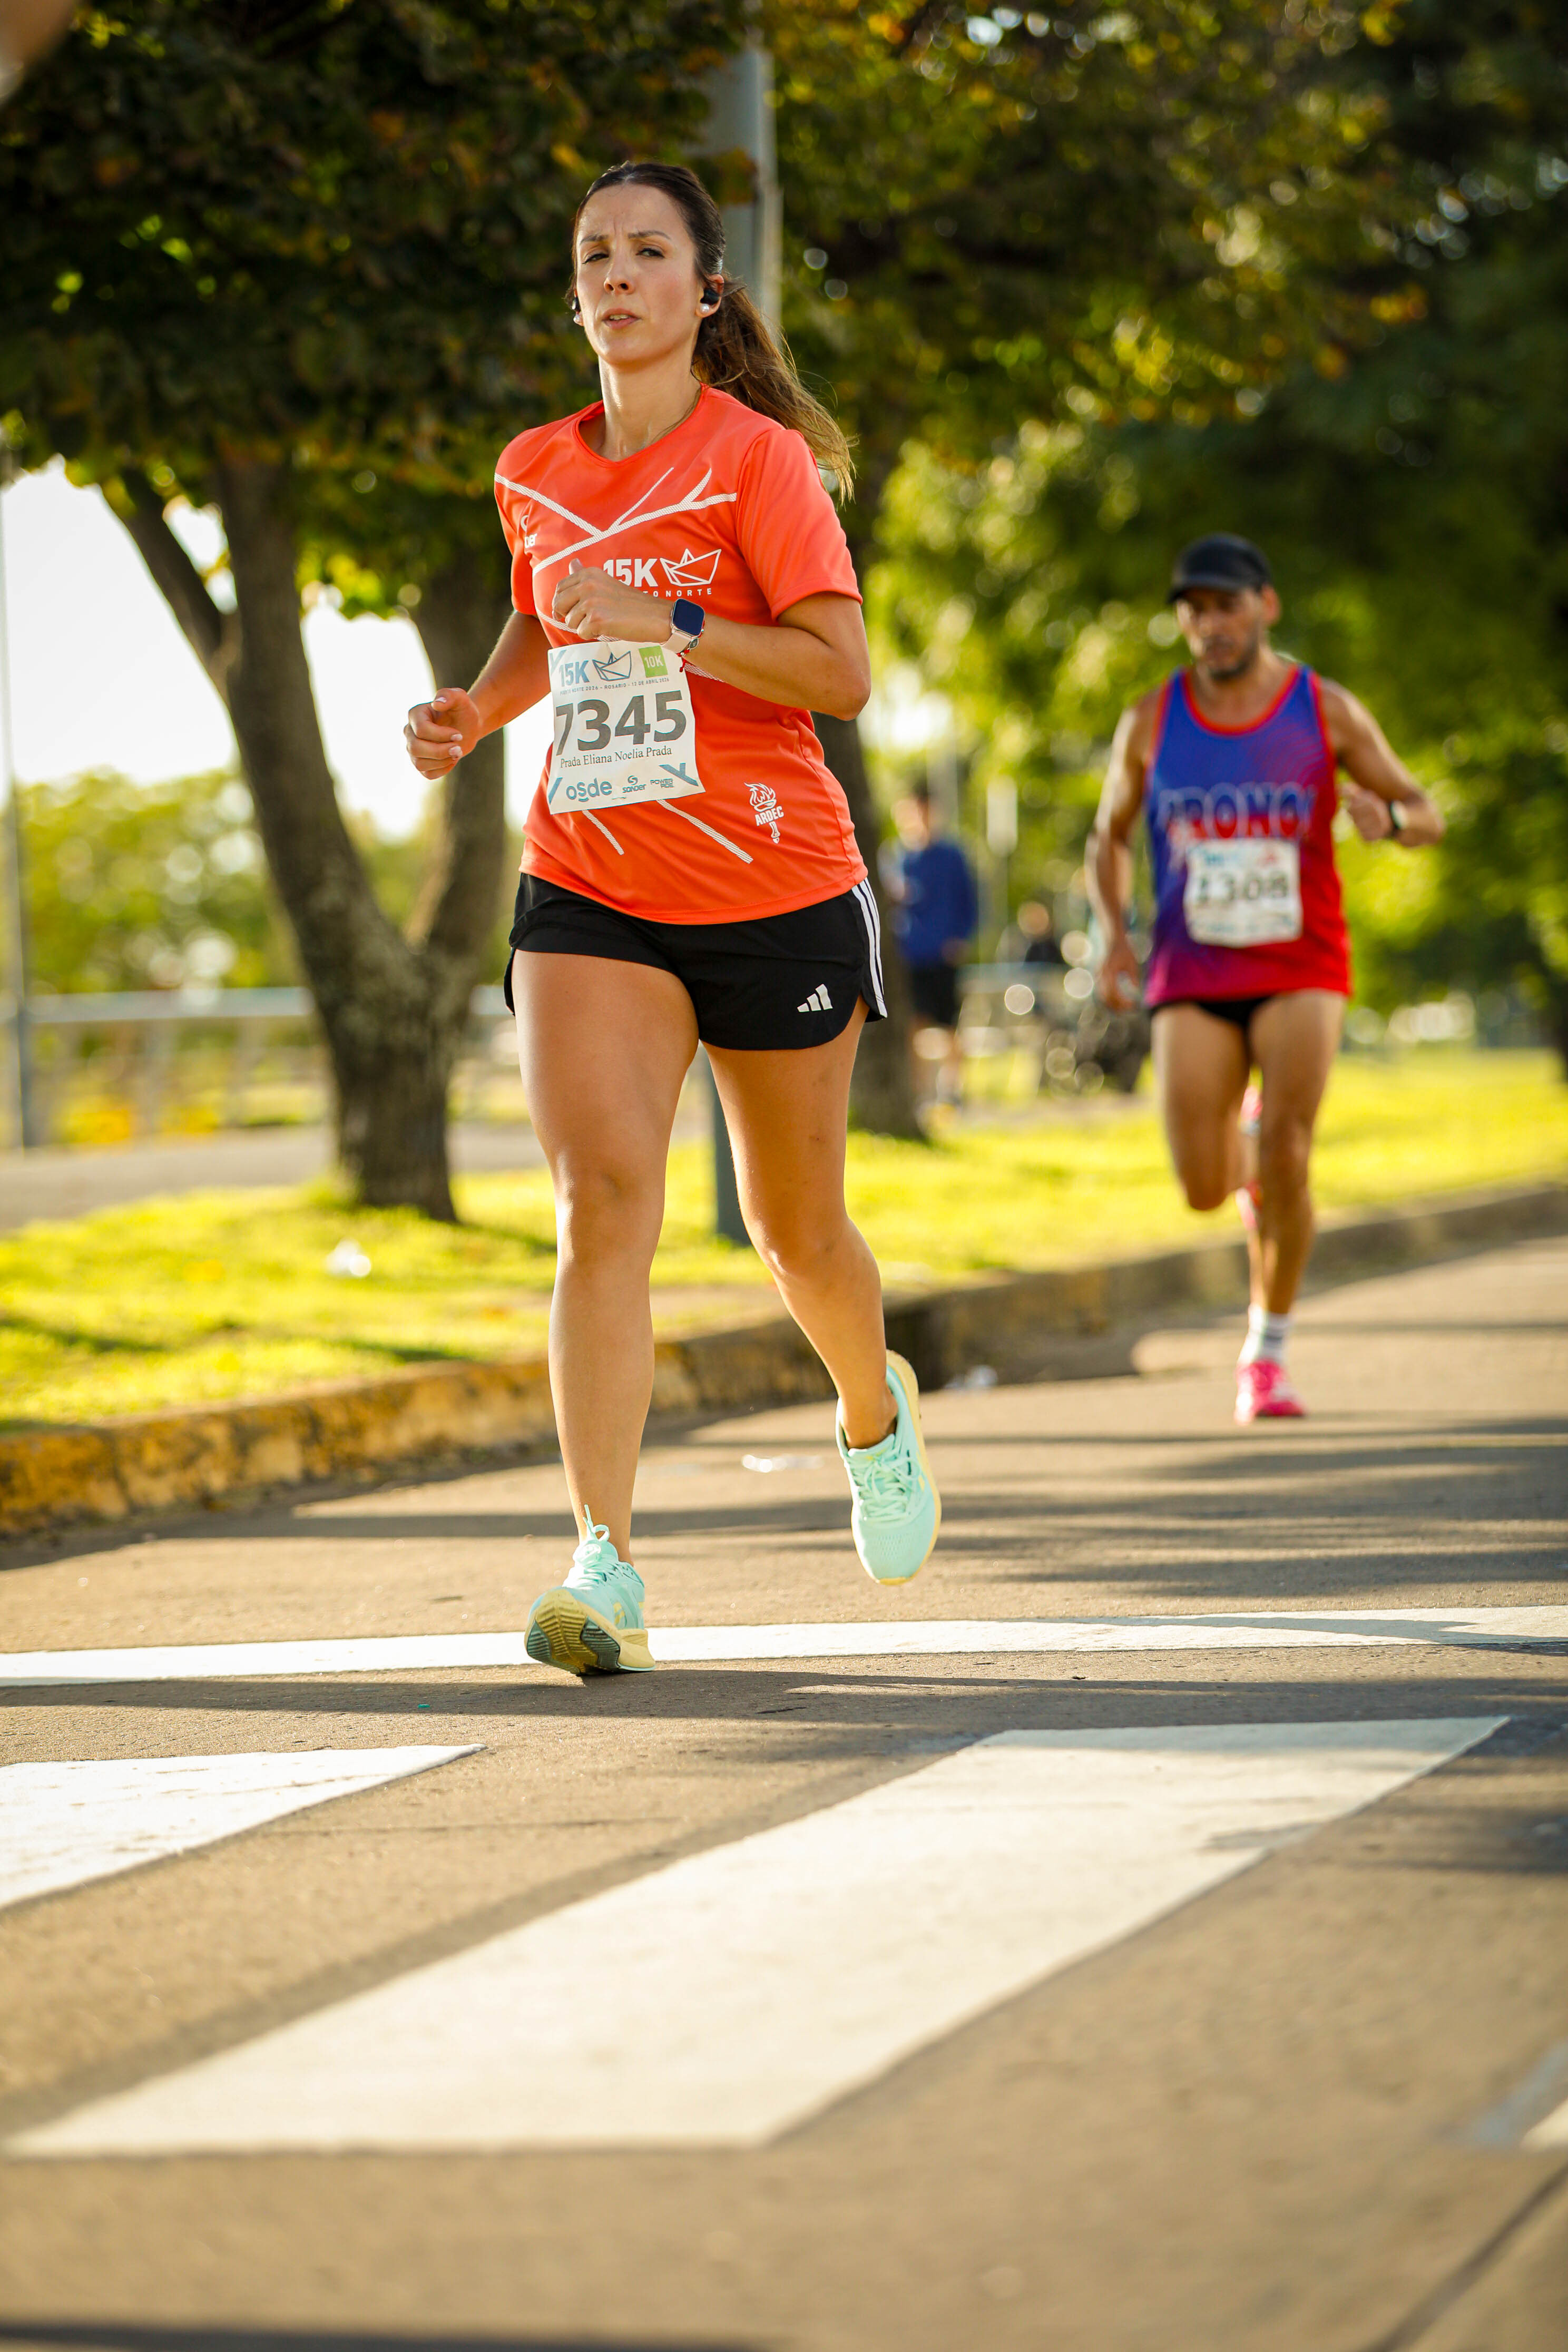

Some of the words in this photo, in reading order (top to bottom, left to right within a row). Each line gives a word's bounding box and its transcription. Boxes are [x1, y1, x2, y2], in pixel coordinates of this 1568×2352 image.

[603, 558, 659, 587] 15K
[665, 588, 712, 597] NORTE
[644, 654, 664, 669] 10K
[559, 660, 590, 687] 15K
[555, 690, 687, 757] 7345
[560, 757, 581, 768] Prada
[583, 754, 612, 766] Eliana
[614, 748, 644, 762] Noelia
[646, 745, 672, 758] Prada
[565, 777, 613, 801] osde
[754, 806, 785, 827] ARDEC
